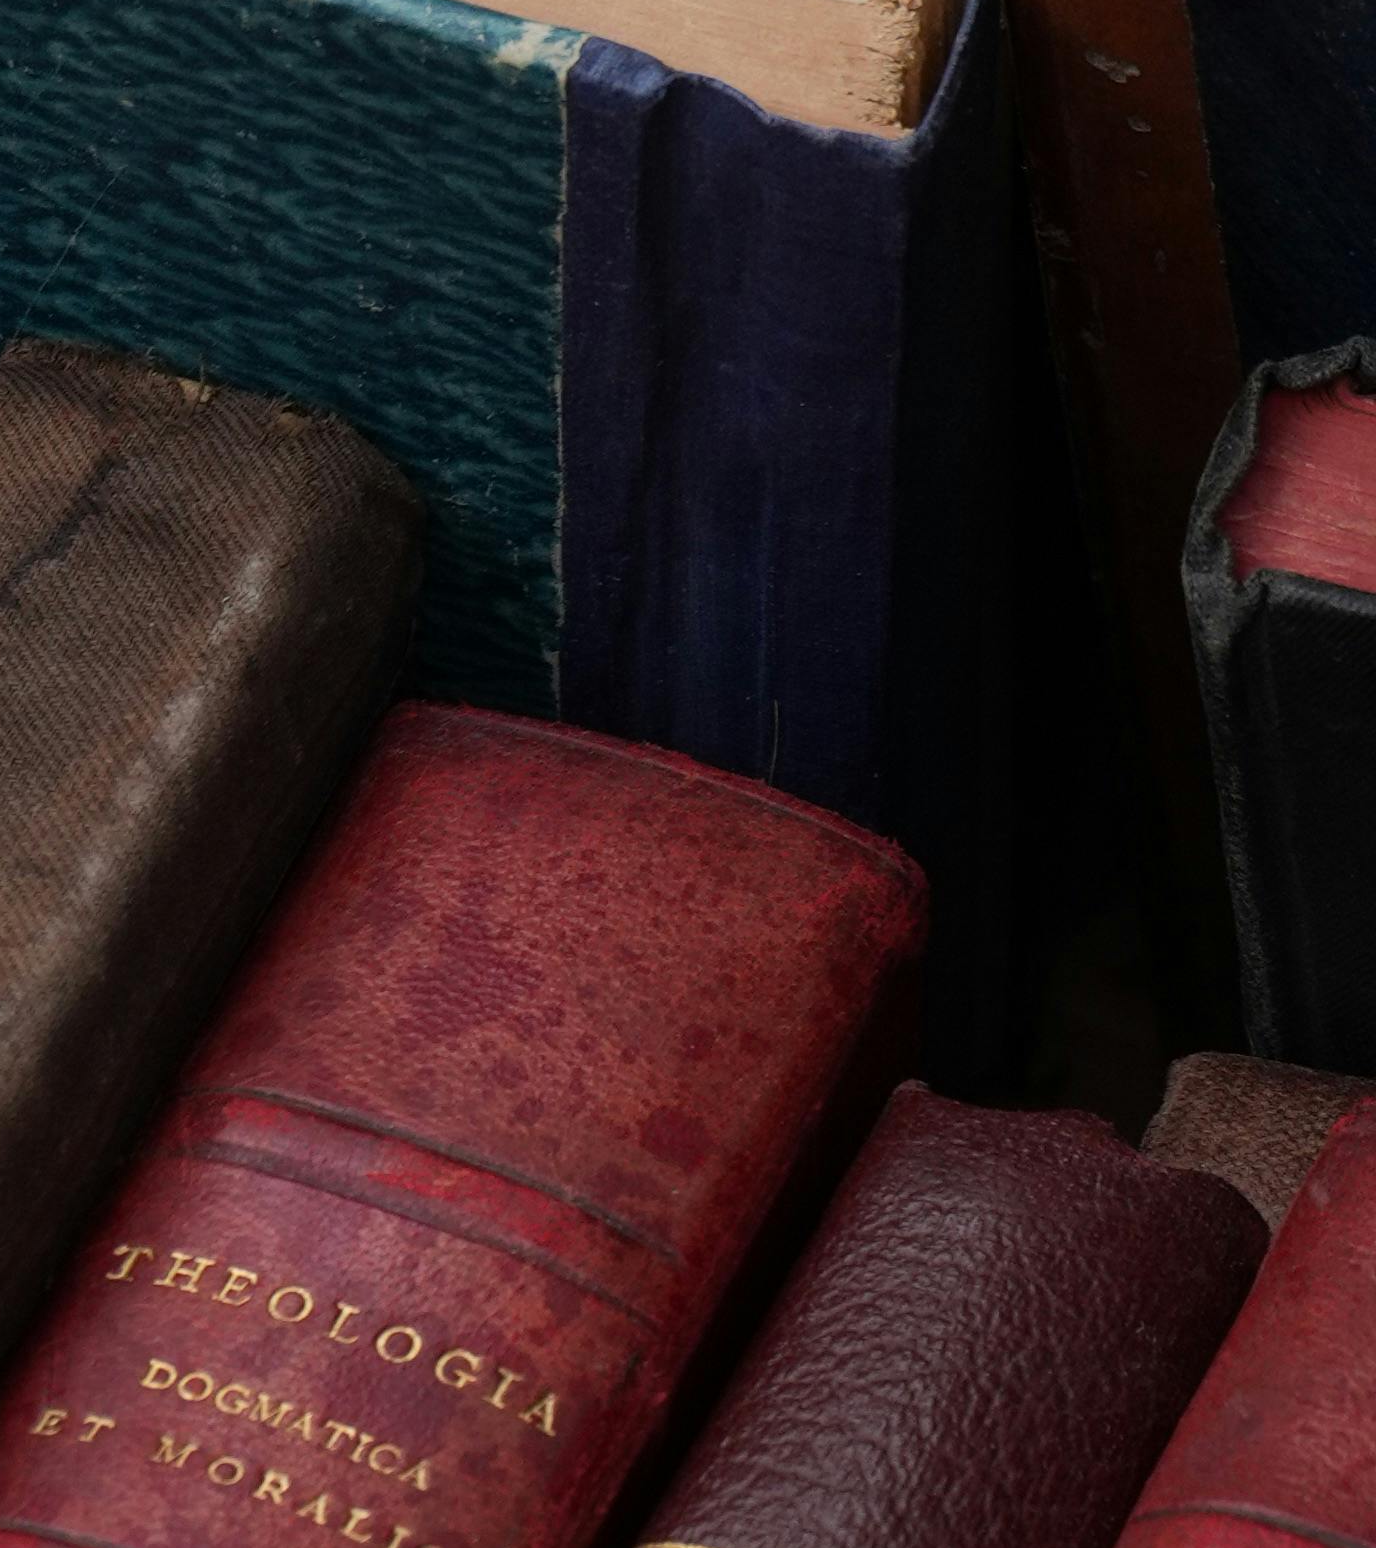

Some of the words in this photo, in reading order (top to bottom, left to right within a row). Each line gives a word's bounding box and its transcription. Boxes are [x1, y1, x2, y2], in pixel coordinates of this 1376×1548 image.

[105, 1242, 561, 1439] THEOLOGIA
[30, 1408, 116, 1443] ET
[139, 1358, 433, 1493] DOGMATICA
